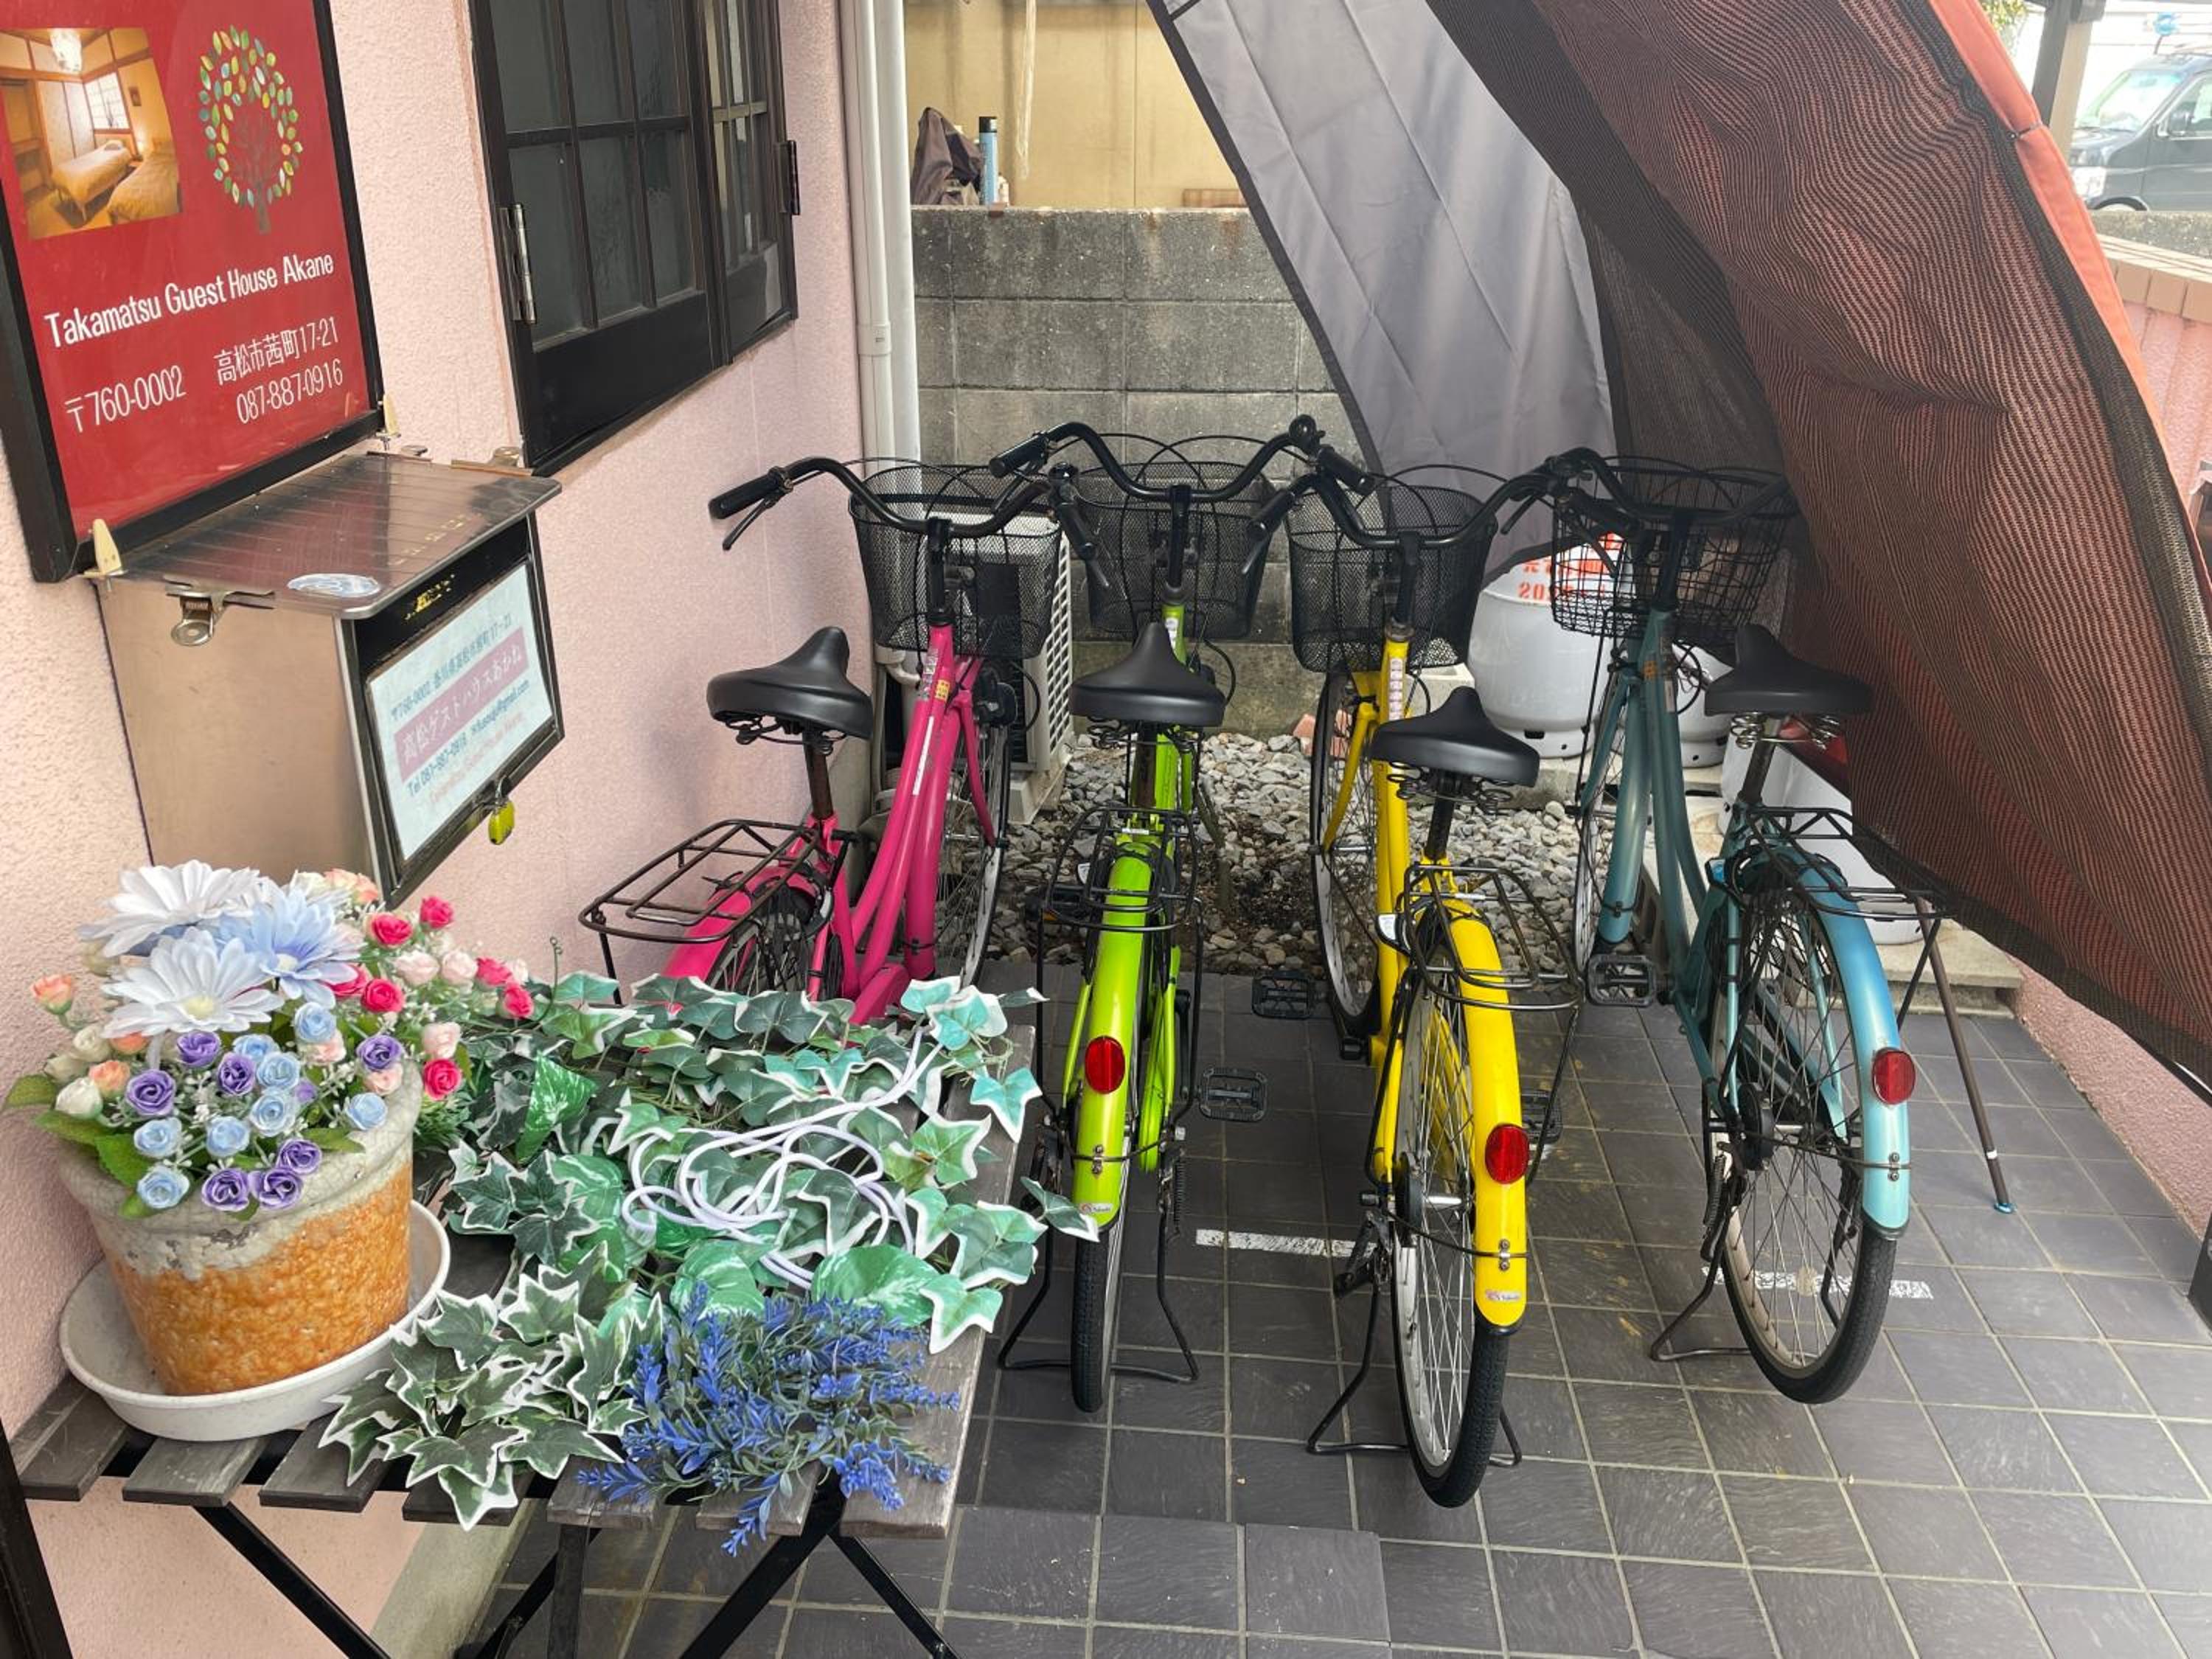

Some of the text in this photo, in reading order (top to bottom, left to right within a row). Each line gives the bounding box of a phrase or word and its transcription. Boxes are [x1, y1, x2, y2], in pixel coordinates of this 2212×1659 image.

[44, 254, 334, 348] Takamatsu Guest House Akane
[213, 316, 339, 386] 高松市茜町17-21
[236, 358, 344, 424] 087-887-0916
